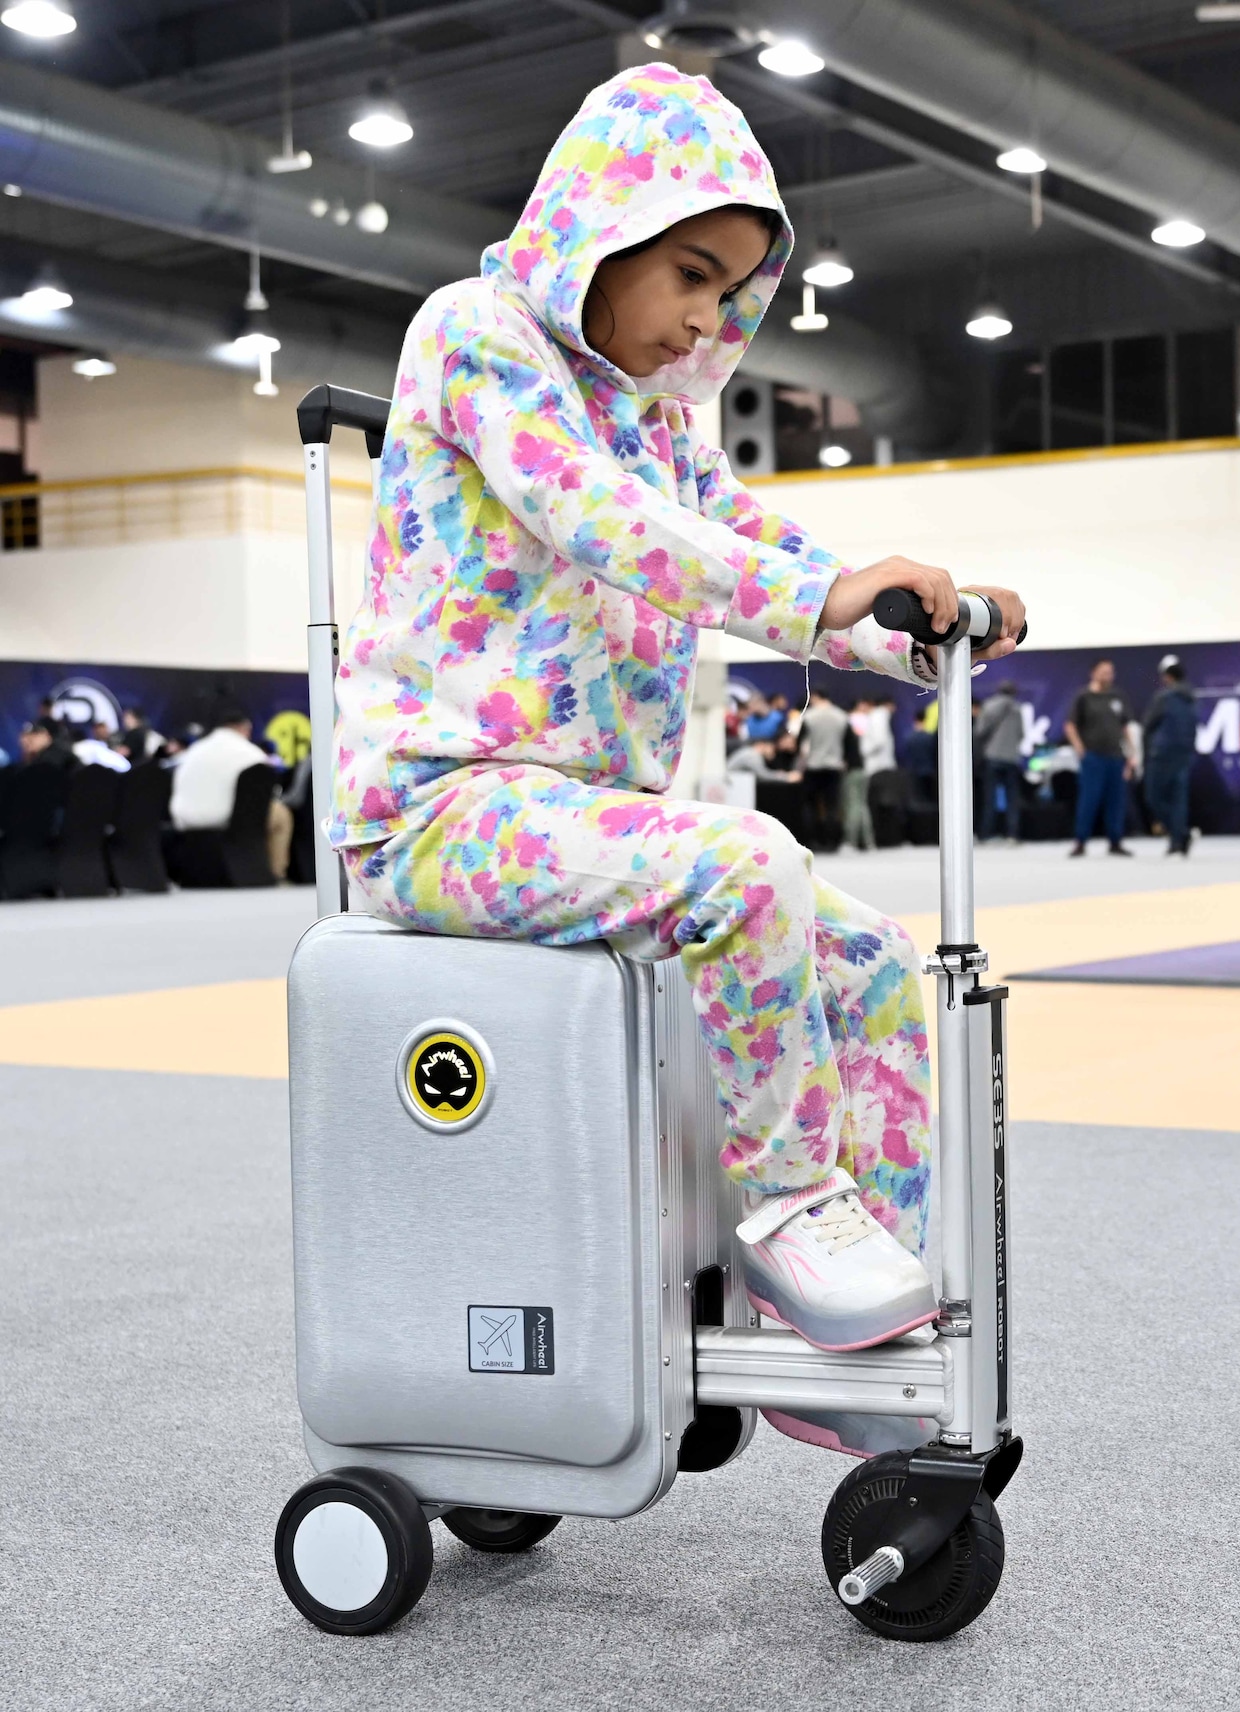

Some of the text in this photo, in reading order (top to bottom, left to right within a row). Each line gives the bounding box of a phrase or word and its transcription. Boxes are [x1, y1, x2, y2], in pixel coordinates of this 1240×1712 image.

[421, 1049, 472, 1078] Airwheel
[992, 1053, 1003, 1150] SE3S
[995, 1173, 1005, 1286] Airwheel
[537, 1312, 548, 1369] Airwheel
